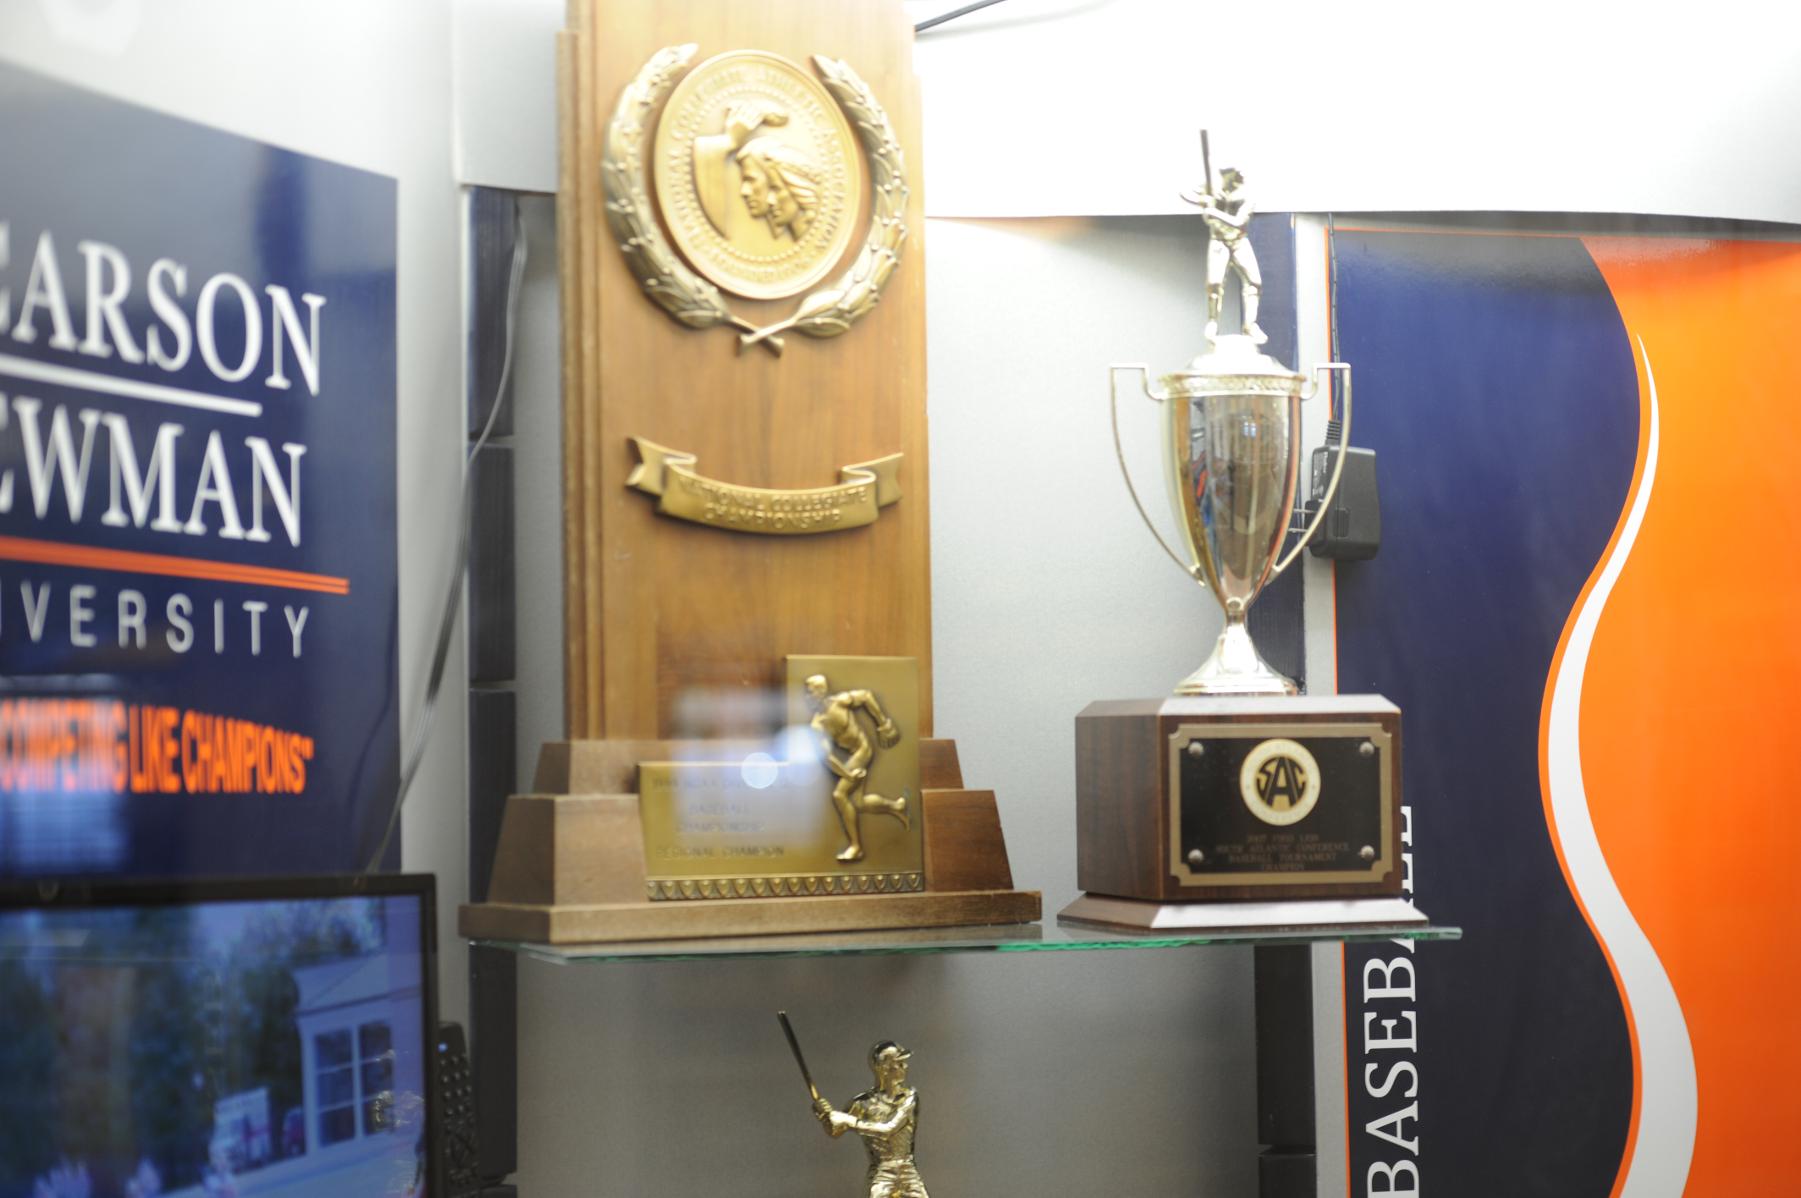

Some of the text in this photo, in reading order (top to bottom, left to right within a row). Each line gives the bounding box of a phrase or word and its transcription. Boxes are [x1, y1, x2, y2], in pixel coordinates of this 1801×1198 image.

[0, 578, 309, 658] VERSITY
[129, 704, 180, 792] LIKE
[1362, 806, 1420, 1198] BASEB
